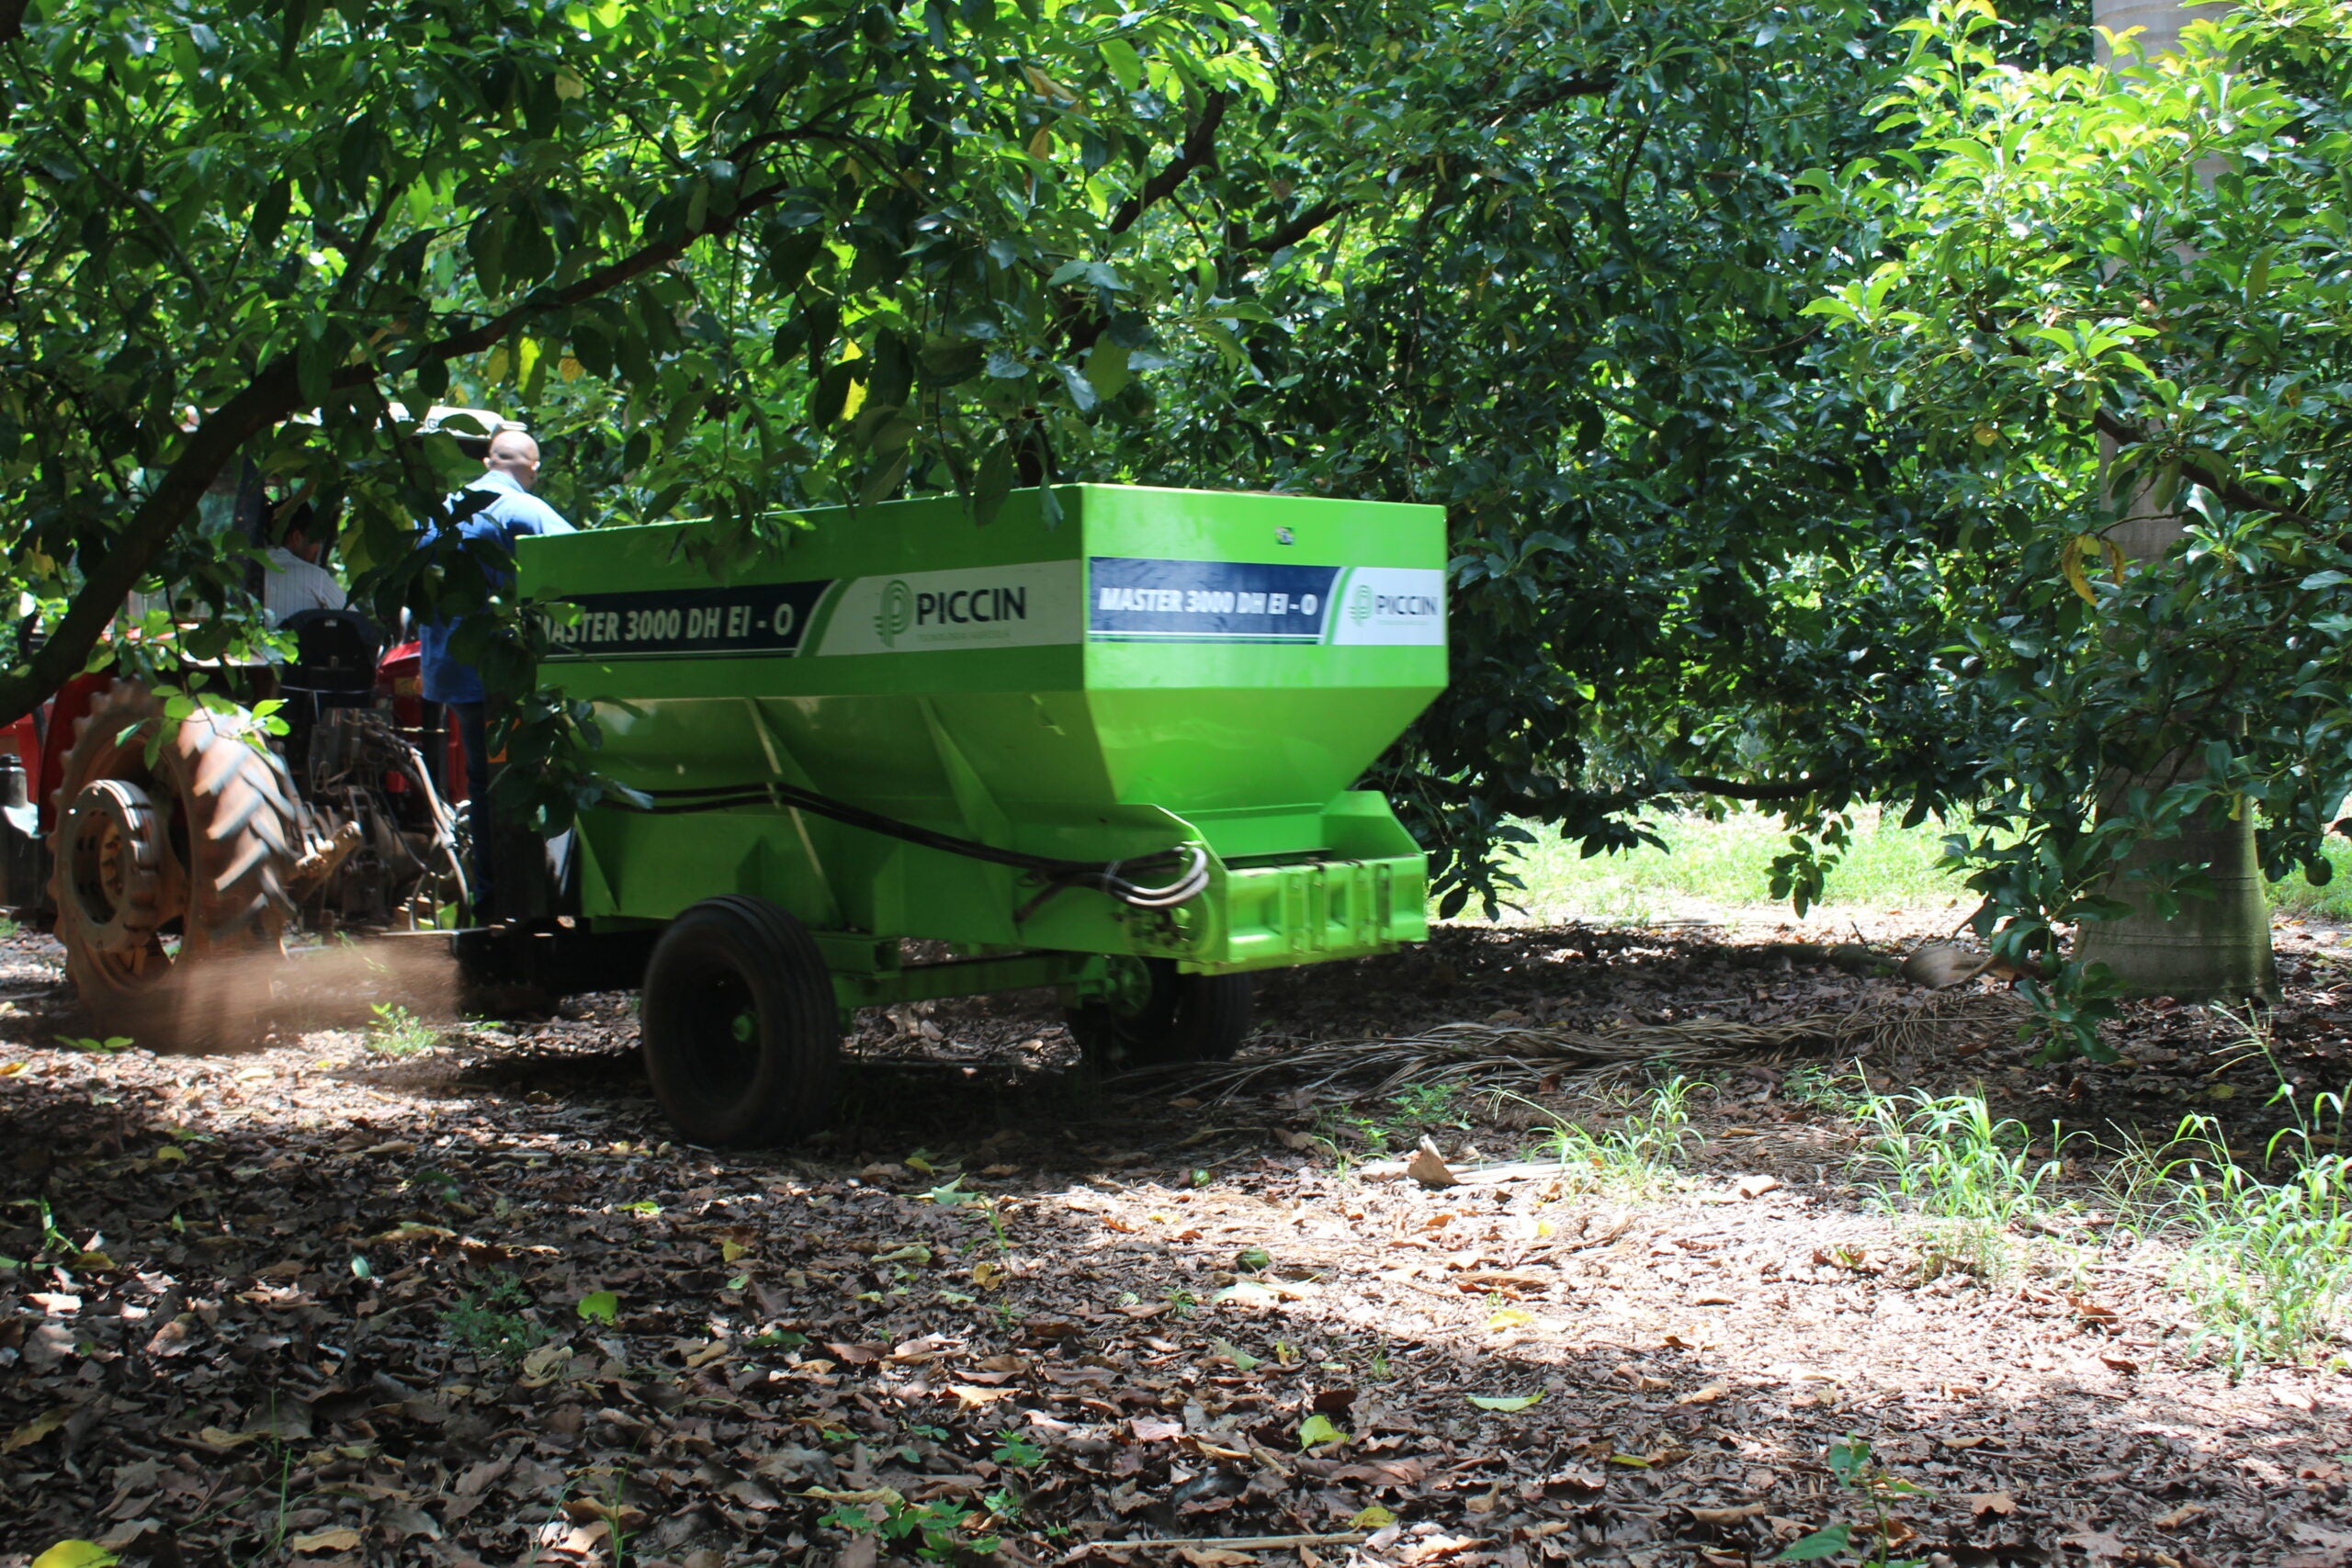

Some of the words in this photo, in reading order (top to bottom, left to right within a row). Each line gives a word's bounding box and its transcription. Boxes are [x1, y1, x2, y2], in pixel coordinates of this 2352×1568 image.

[916, 586, 1026, 626] PICCIN
[1099, 587, 1183, 612] MASTER
[1184, 590, 1236, 613] 3000
[1236, 592, 1267, 614] DH
[1375, 595, 1438, 615] PICCIN
[625, 608, 682, 641] 3000
[686, 606, 721, 638] DH
[726, 605, 752, 637] EI
